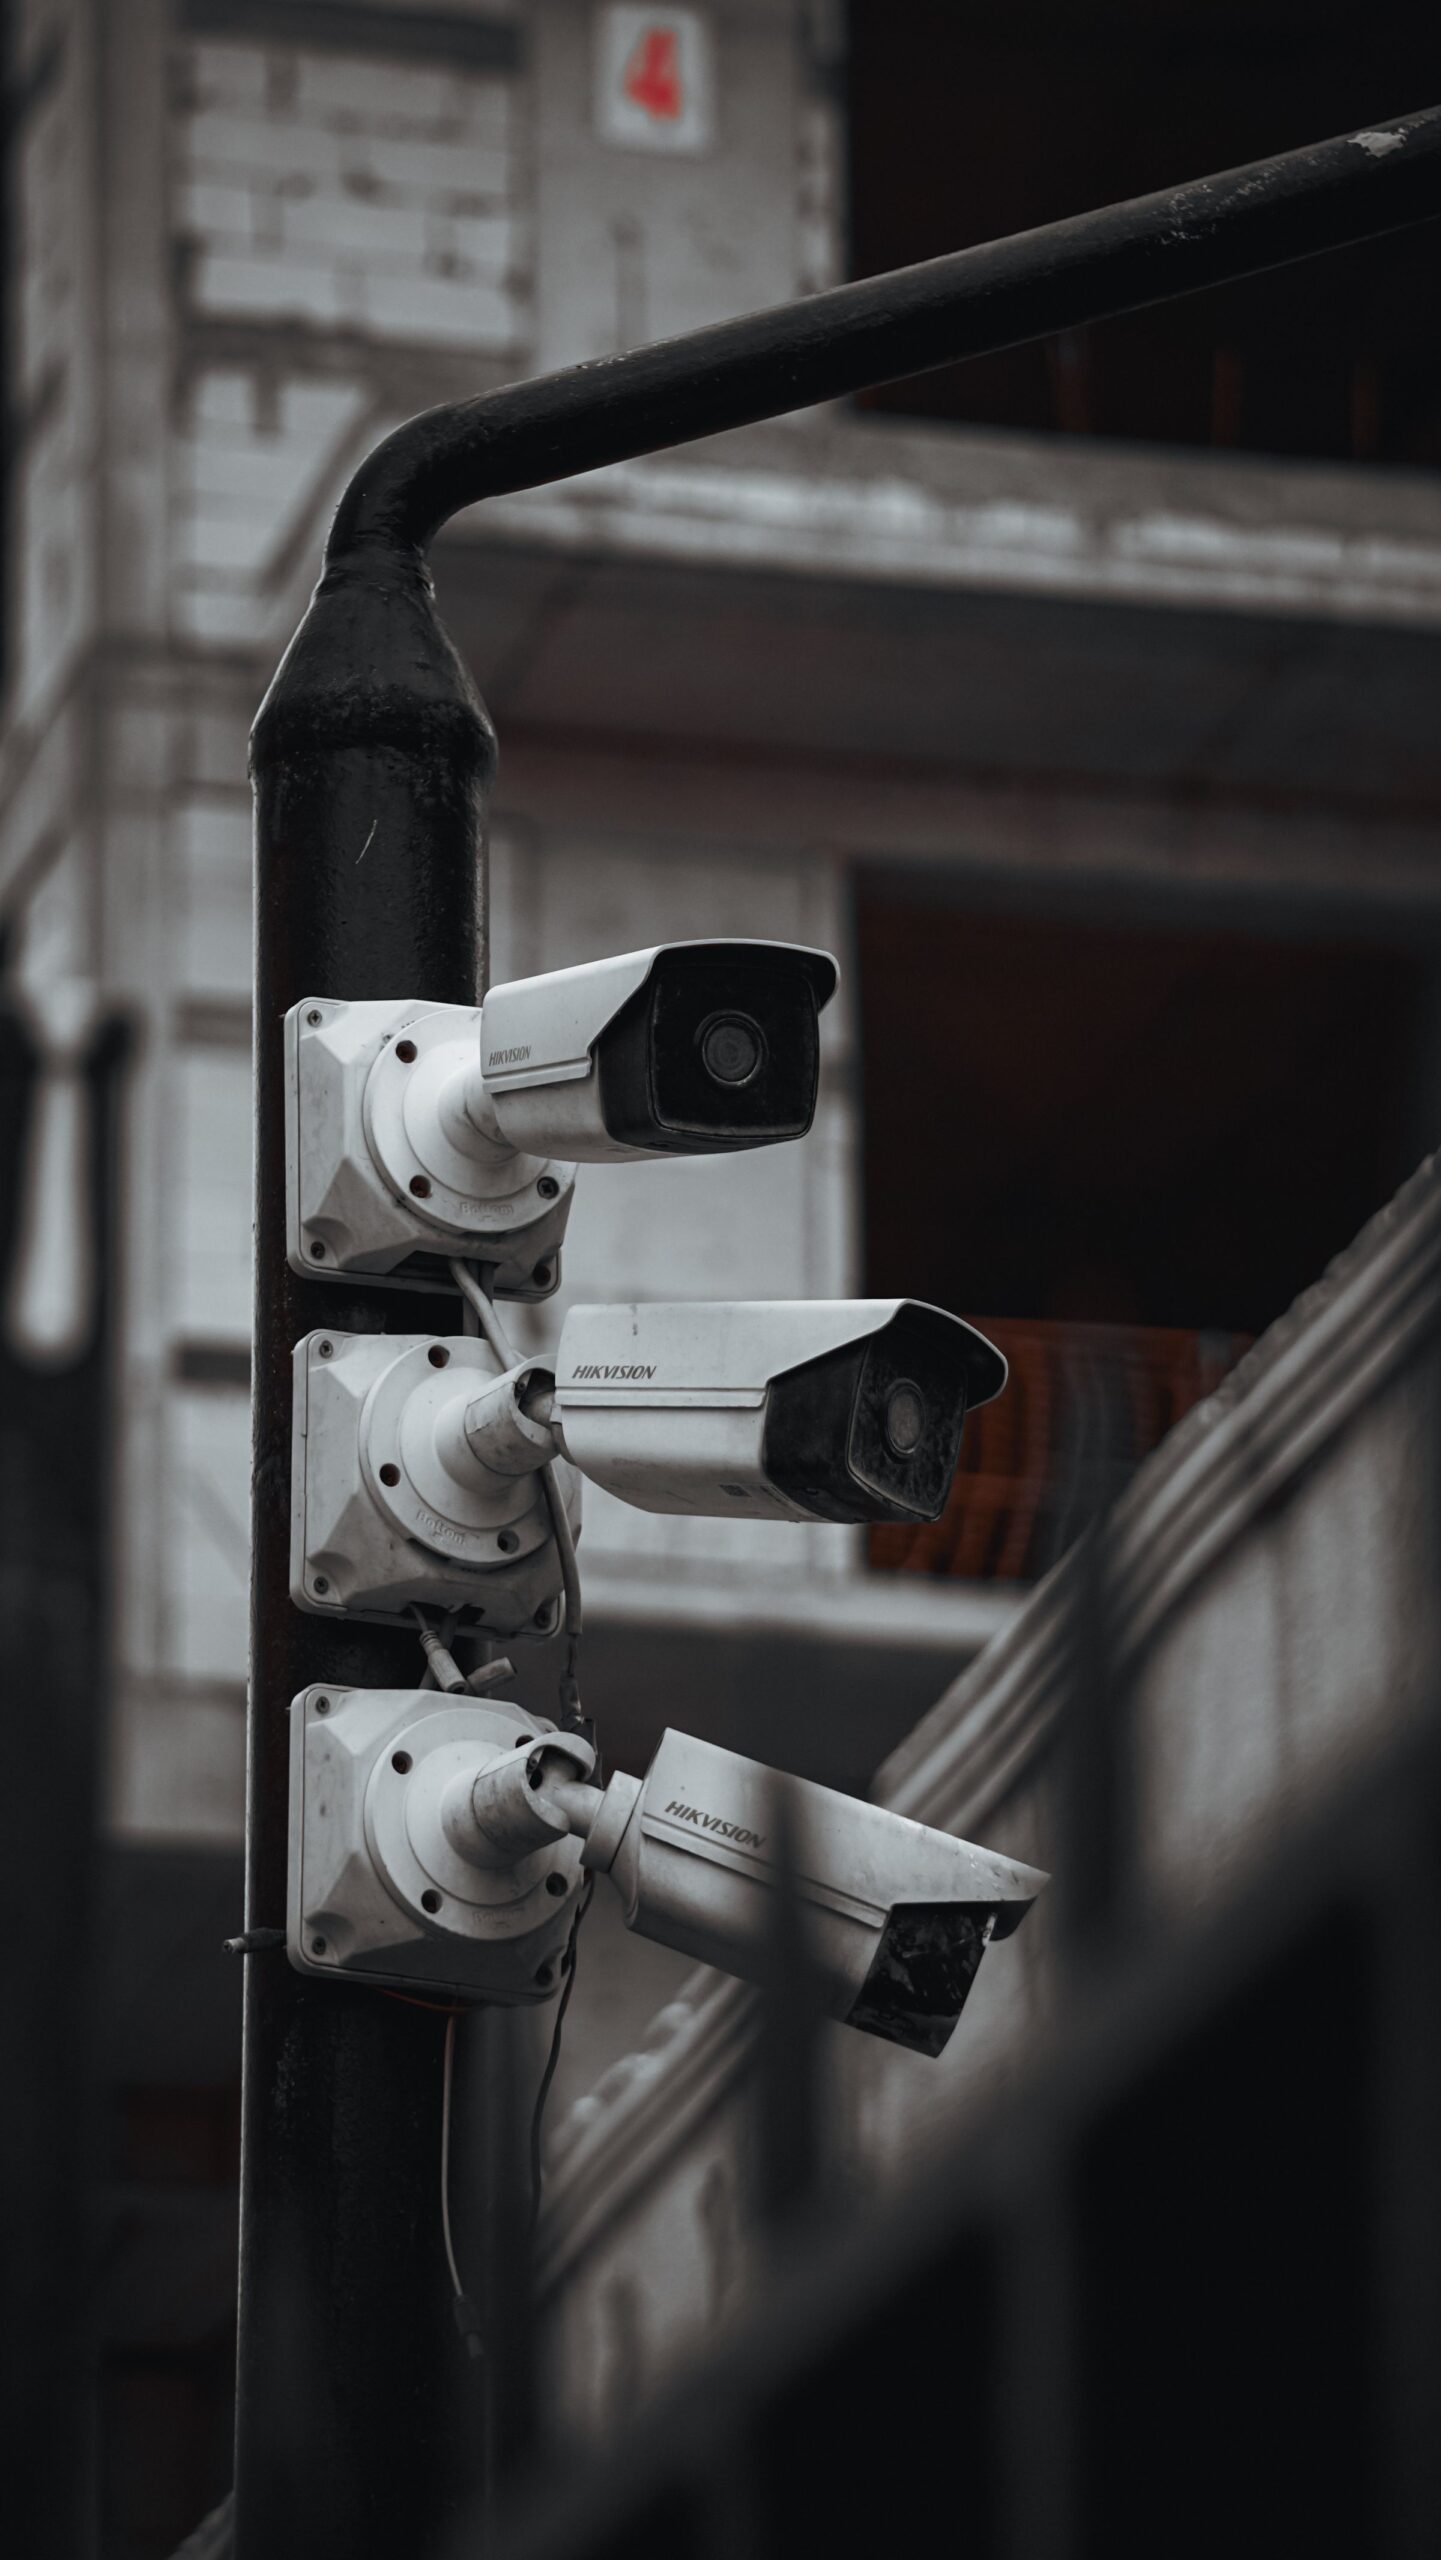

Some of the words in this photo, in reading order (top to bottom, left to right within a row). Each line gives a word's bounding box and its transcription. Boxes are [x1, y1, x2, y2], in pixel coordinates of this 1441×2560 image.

[624, 26, 683, 121] 4
[489, 1045, 532, 1066] HIKVISION
[572, 1365, 657, 1380] HIKVISION
[664, 1801, 766, 1848] HIKVISION
